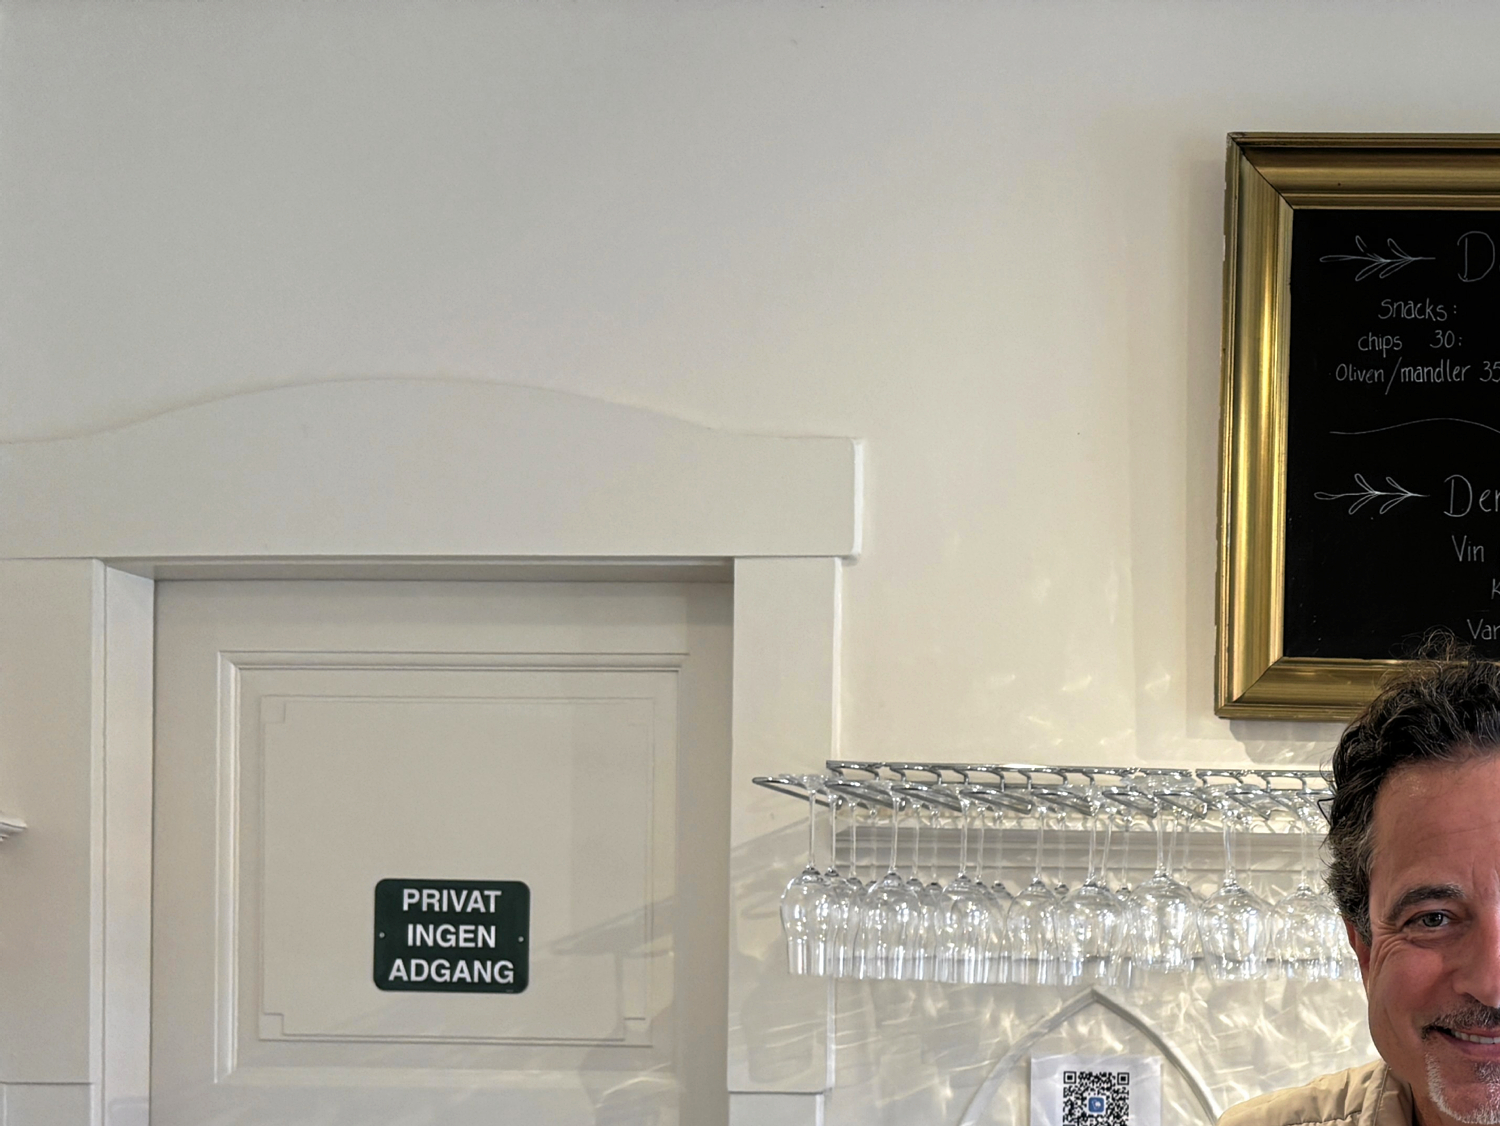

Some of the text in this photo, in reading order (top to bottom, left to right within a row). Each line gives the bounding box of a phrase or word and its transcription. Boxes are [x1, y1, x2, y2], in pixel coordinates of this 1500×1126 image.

[1357, 331, 1403, 359] chips
[1450, 533, 1485, 564] Vin
[402, 888, 502, 913] PRIVAT
[407, 923, 496, 948] INGEN
[388, 958, 515, 984] ADGANG
